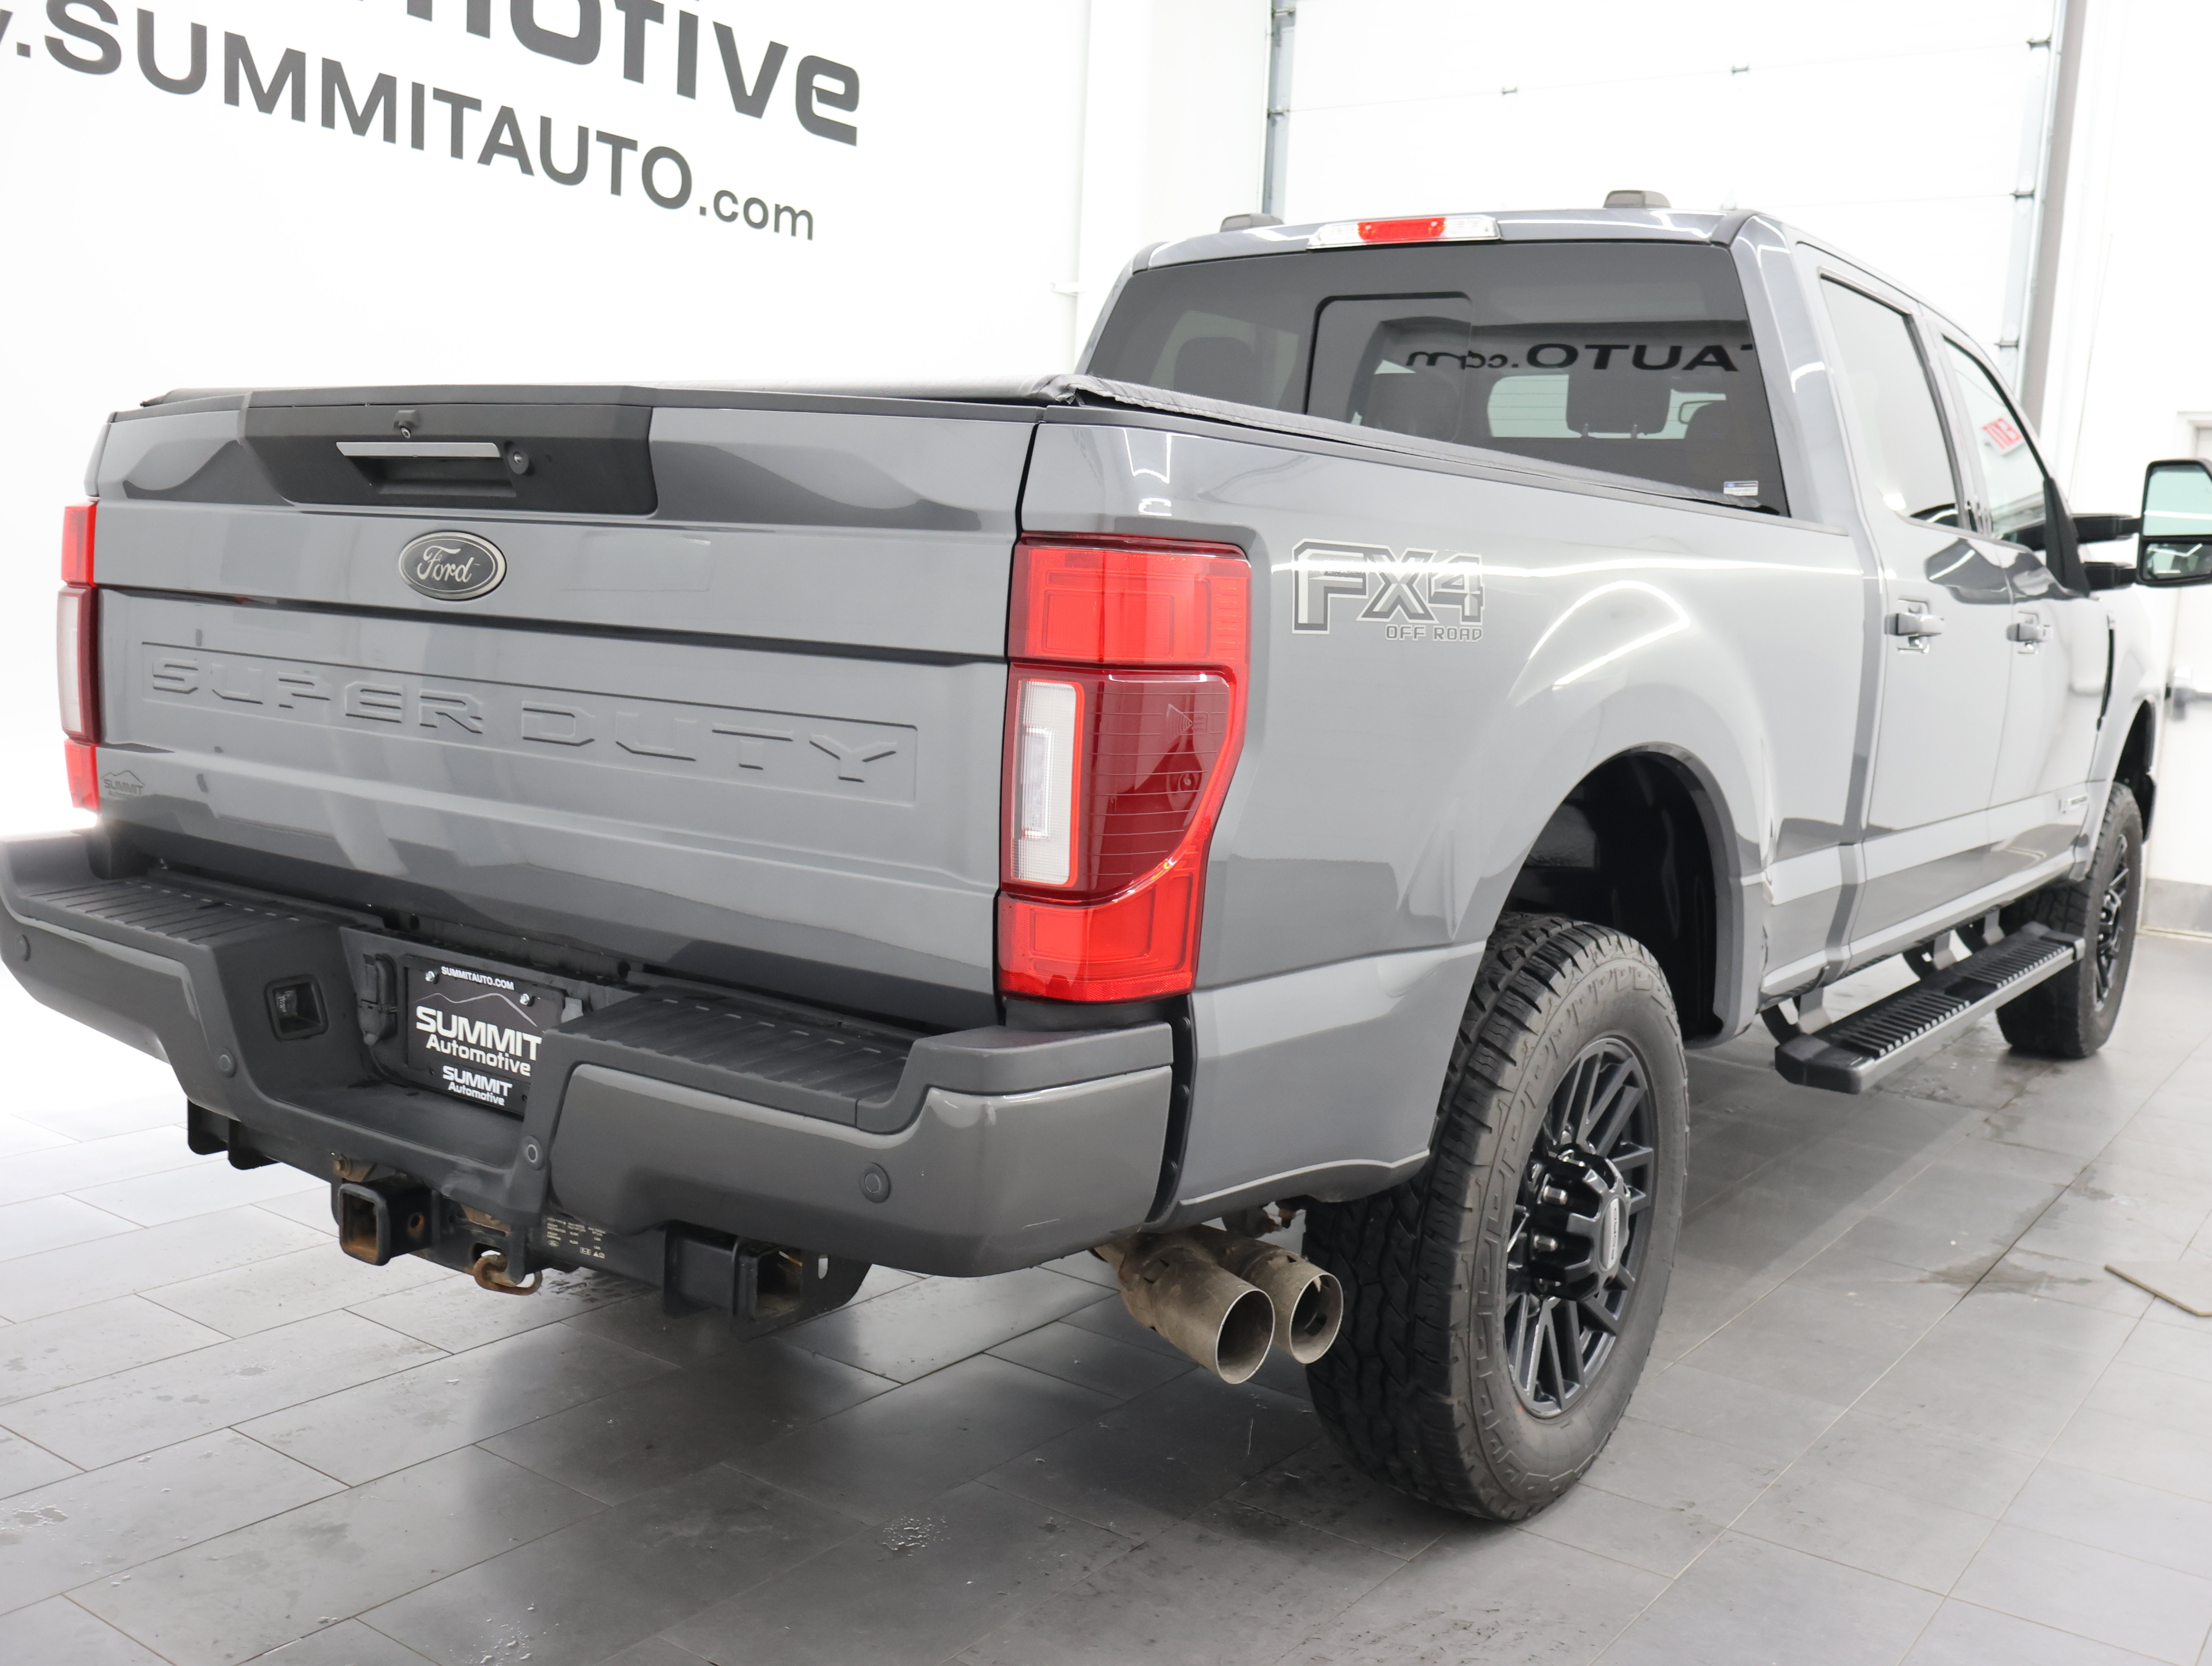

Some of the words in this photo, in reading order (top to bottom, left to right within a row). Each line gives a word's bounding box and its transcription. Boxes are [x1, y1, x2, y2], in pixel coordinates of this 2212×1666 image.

[417, 545, 474, 583] Ford
[1291, 538, 1485, 635] FX4
[1385, 624, 1426, 641] OFF
[1433, 626, 1483, 642] ROAD
[152, 657, 483, 734] SUPER
[521, 700, 898, 782] DUTY
[441, 966, 515, 991] SUMMITAUTO.COM
[416, 1005, 542, 1061] SUMMIT
[425, 1034, 531, 1077] Automotive
[442, 1065, 513, 1097] SUMMIT
[447, 1081, 505, 1106] Automotive
